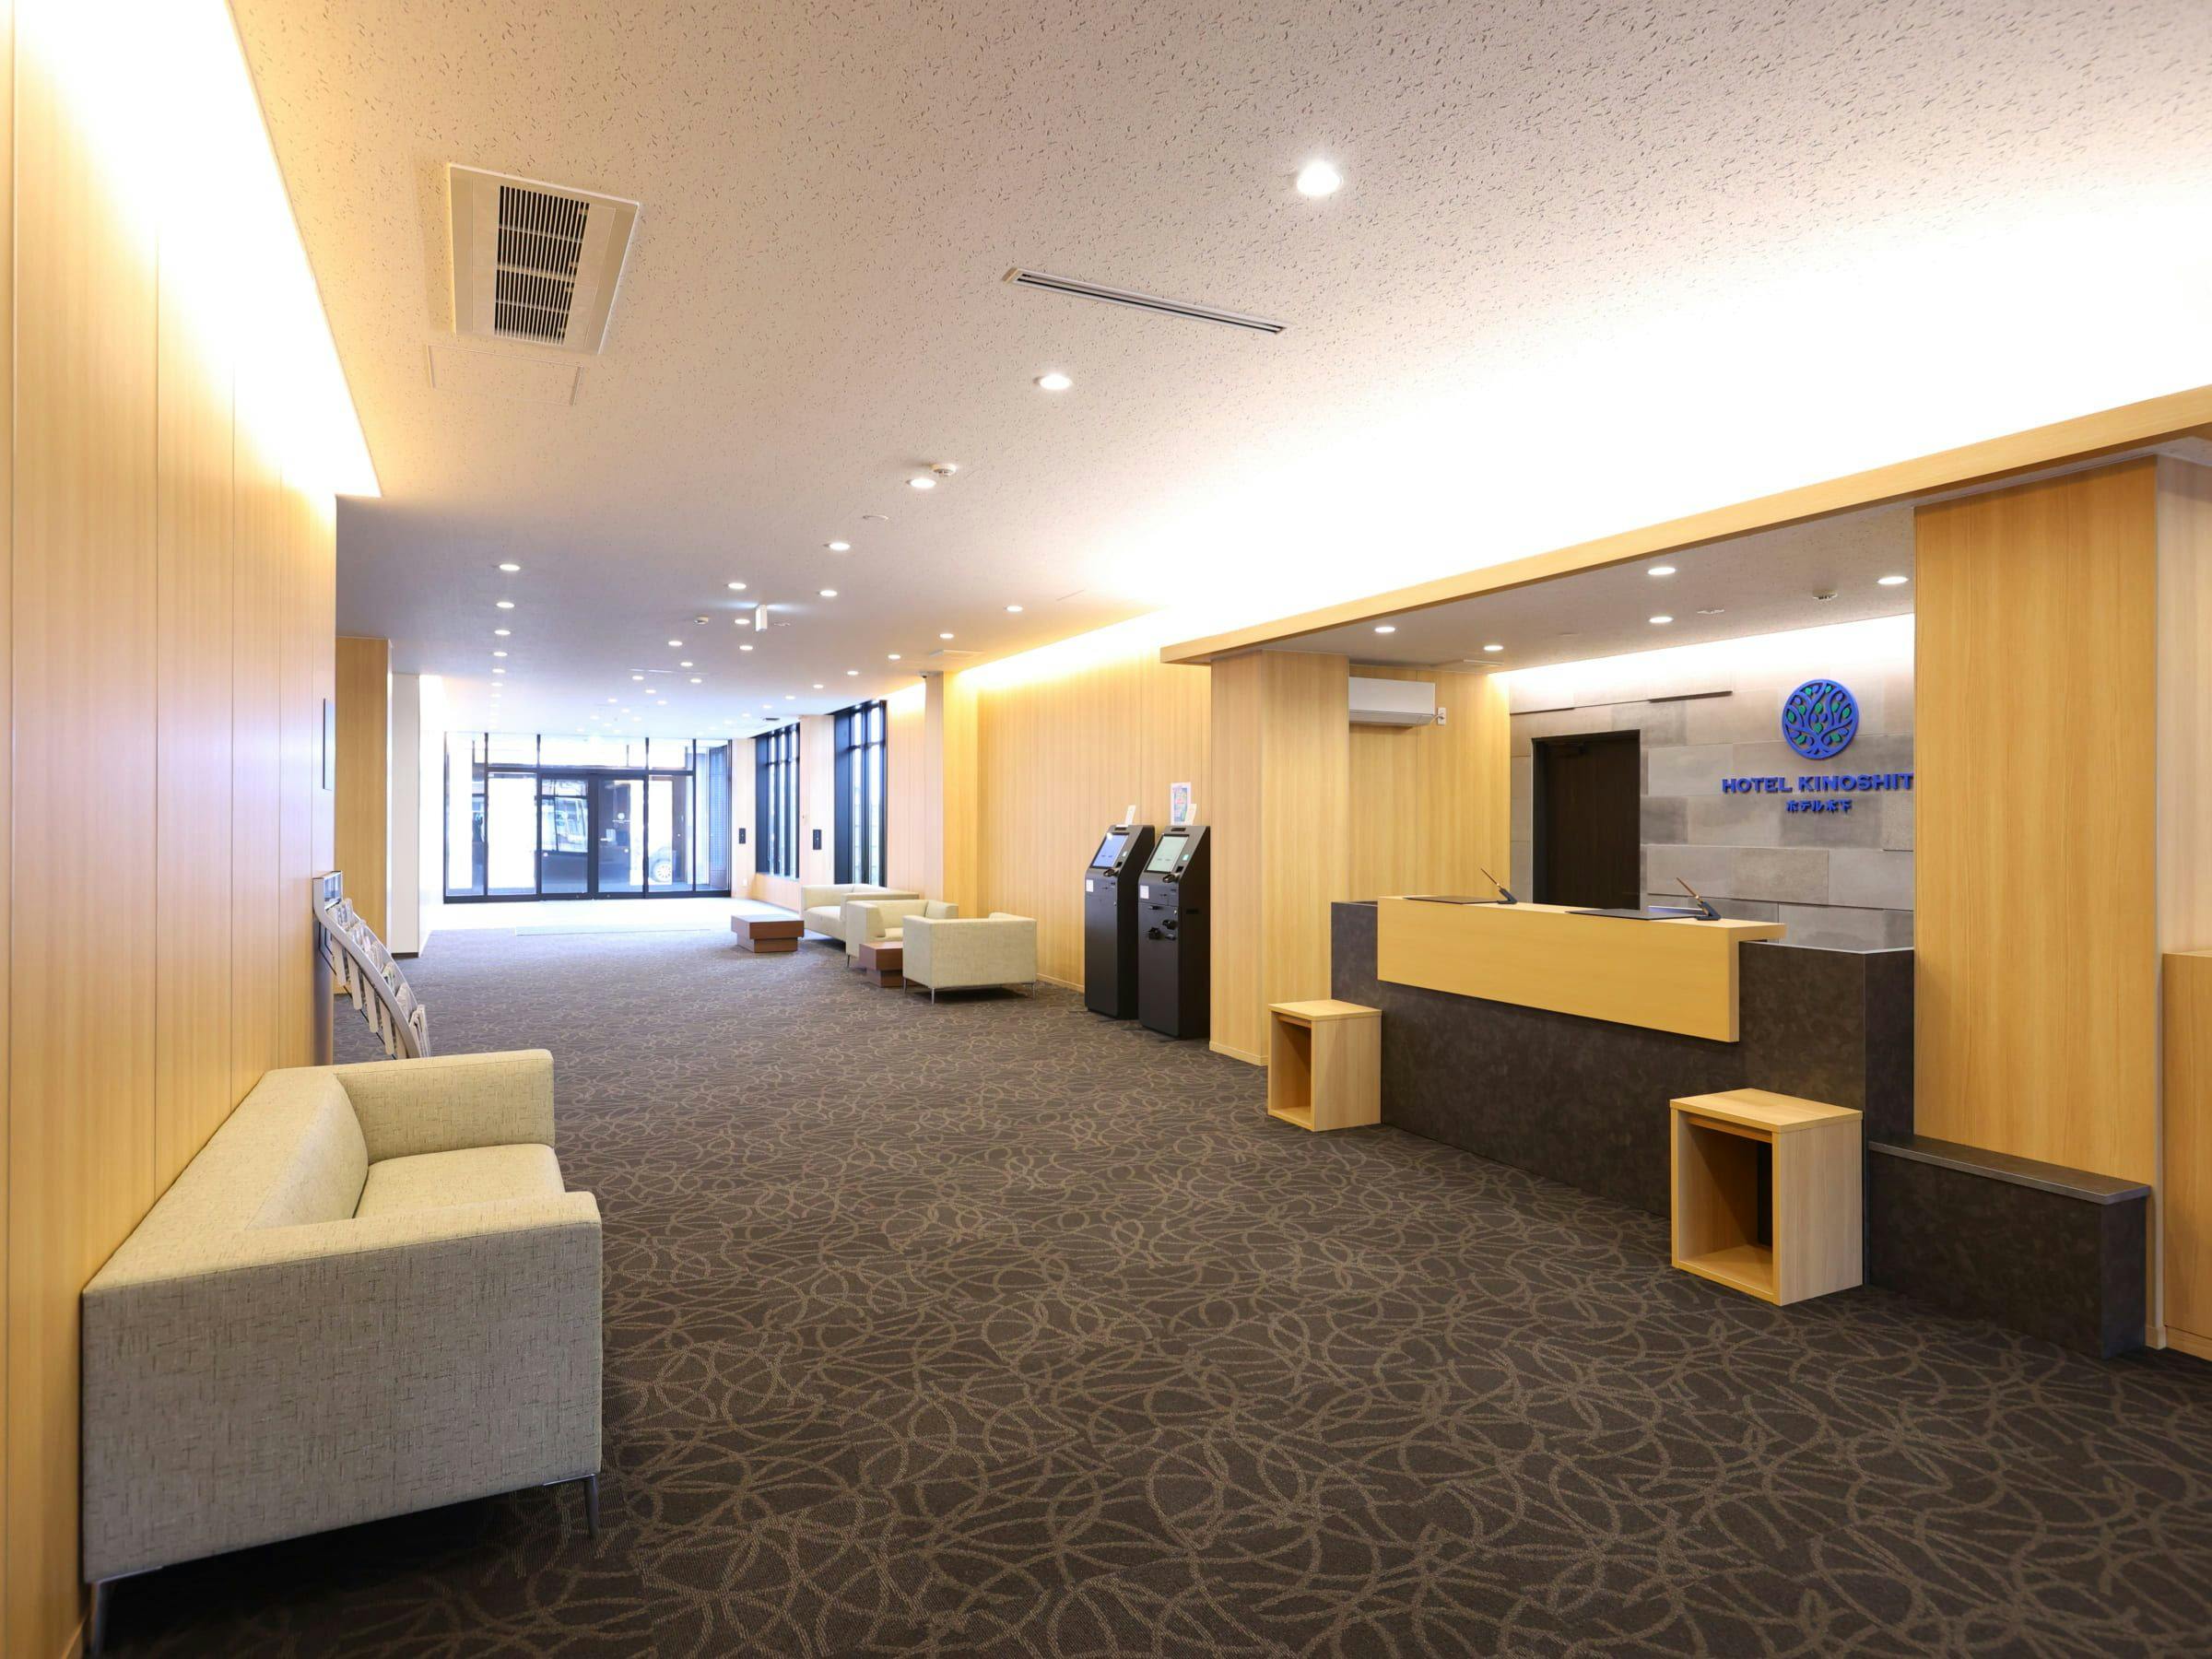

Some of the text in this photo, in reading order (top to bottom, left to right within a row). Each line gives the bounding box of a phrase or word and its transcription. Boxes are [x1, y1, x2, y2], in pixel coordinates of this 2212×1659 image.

[1722, 772, 1914, 794] HOTEL KINOSHIT
[1786, 800, 1852, 813] ホテル木下
